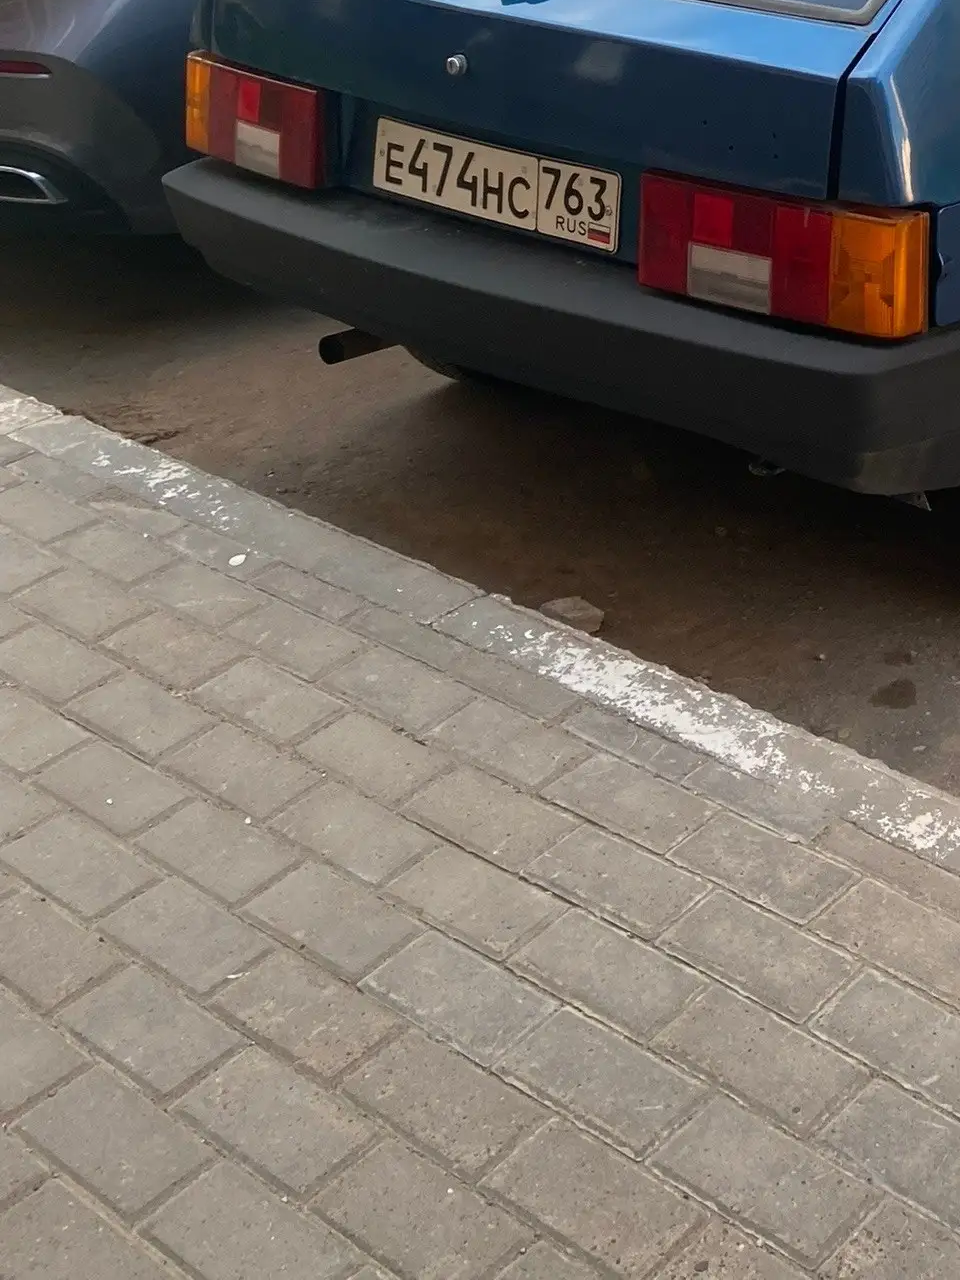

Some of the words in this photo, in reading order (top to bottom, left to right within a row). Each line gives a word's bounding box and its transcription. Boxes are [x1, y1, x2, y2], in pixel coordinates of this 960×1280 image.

[385, 138, 531, 220] Е474НС
[541, 167, 608, 222] 763
[556, 215, 587, 237] RUS
